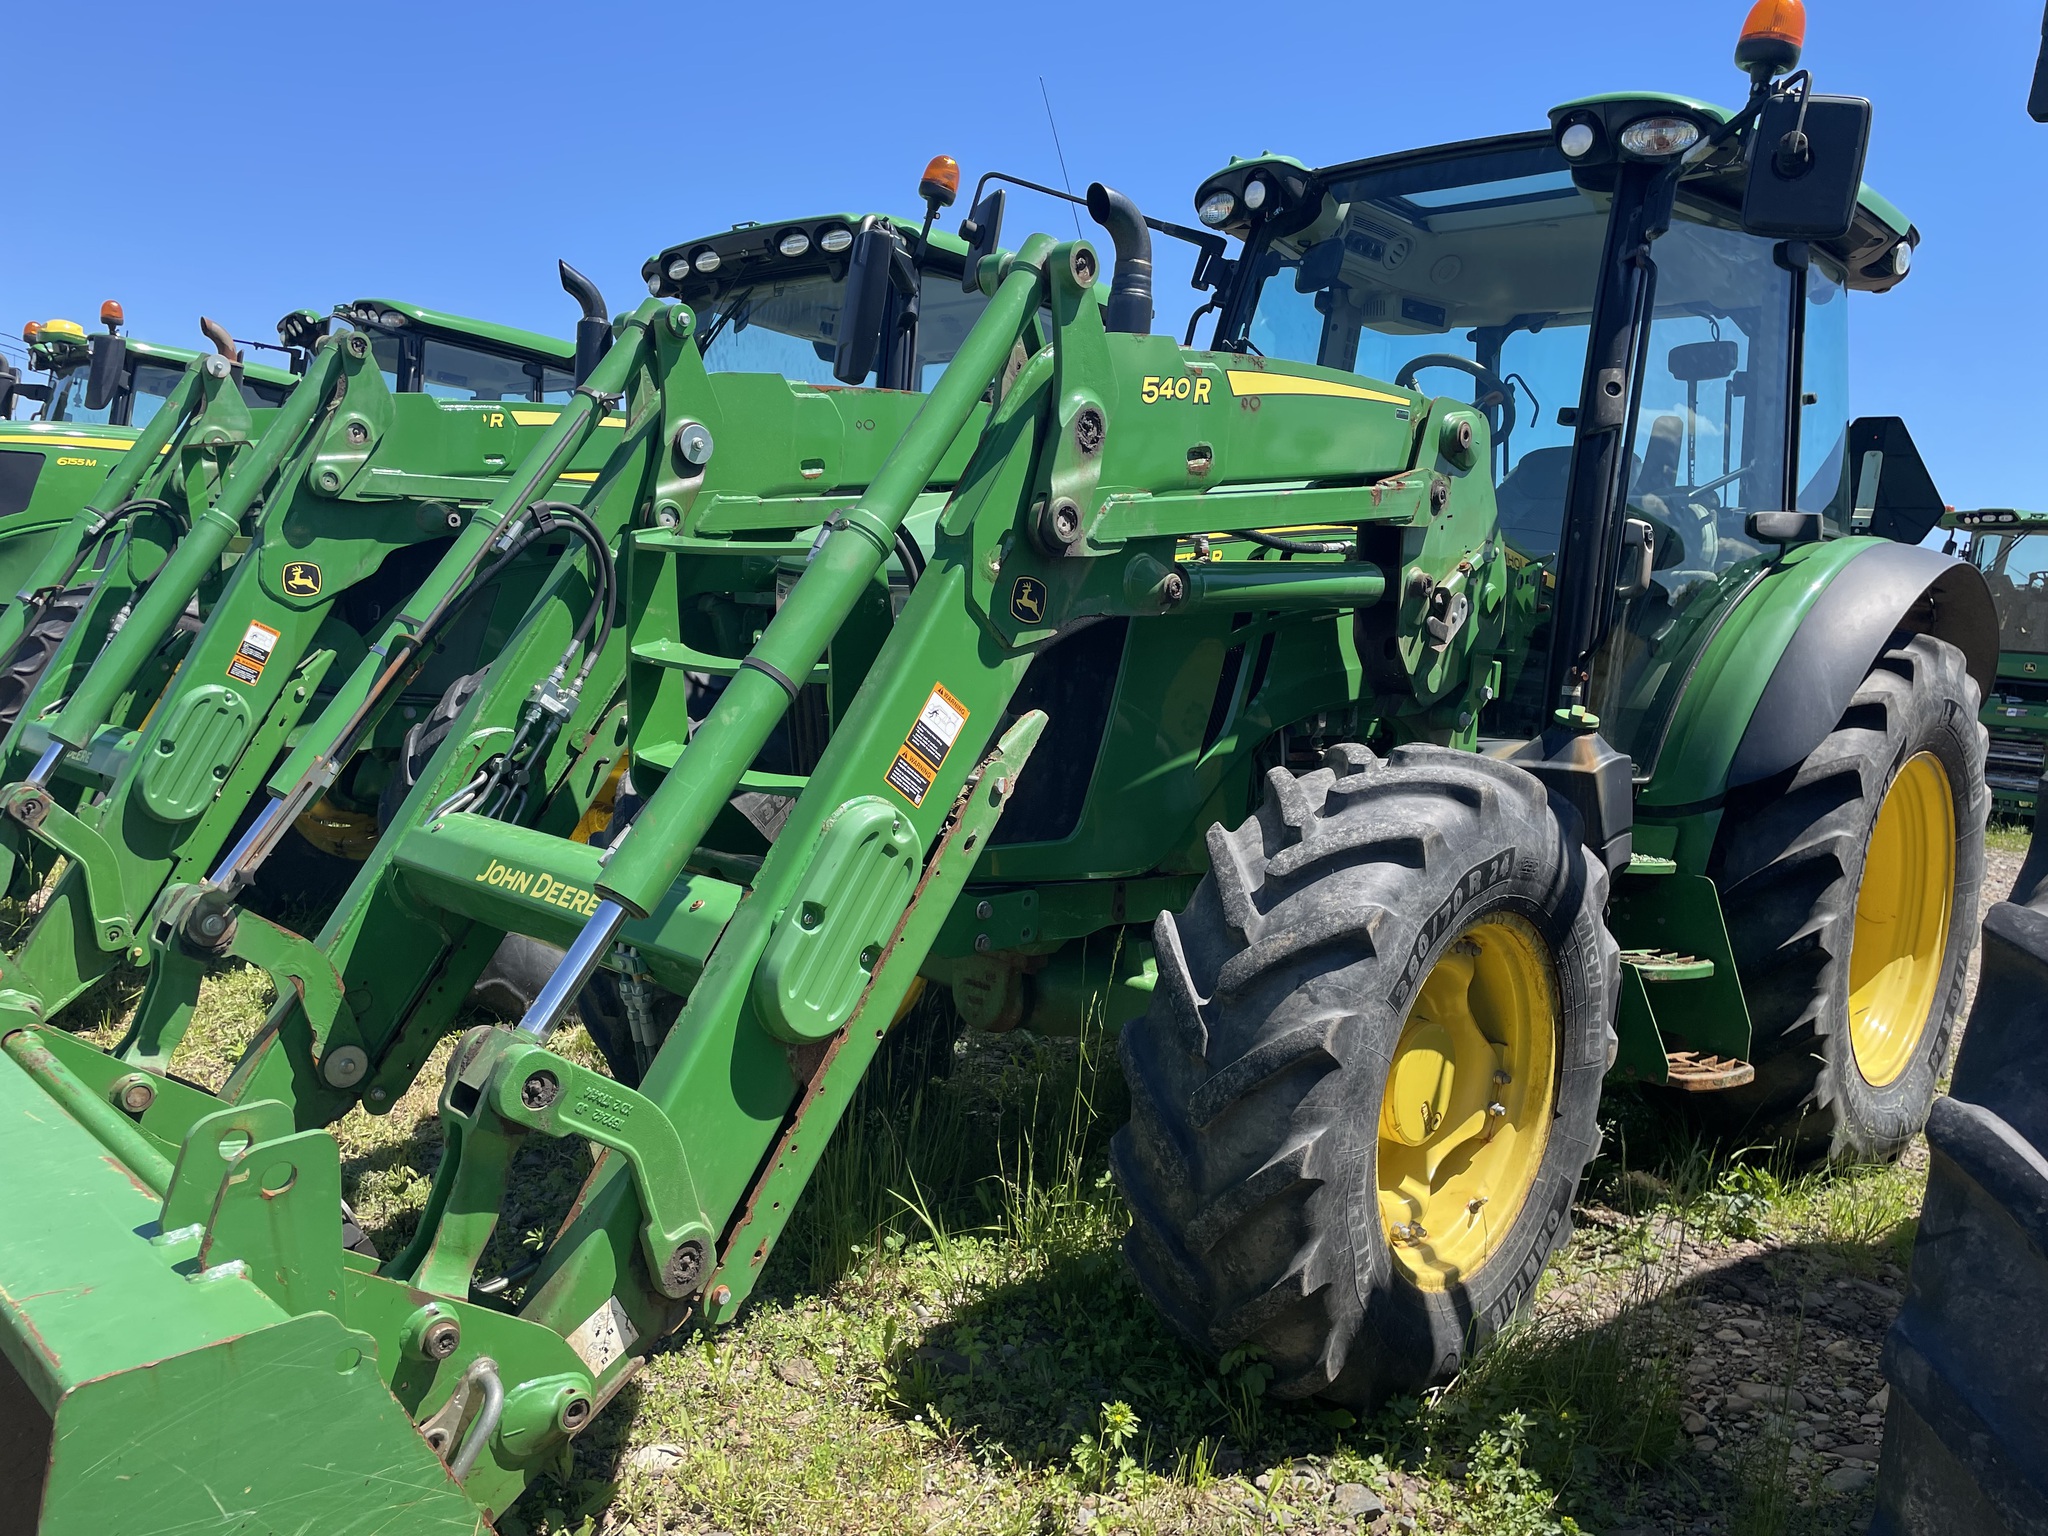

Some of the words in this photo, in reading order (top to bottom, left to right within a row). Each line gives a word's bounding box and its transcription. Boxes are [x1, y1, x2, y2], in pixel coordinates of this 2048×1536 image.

[943, 690, 966, 716] WARNING
[909, 756, 932, 779] WARNING
[475, 859, 535, 894] JOHN
[530, 873, 603, 917] DEERE
[1395, 886, 1464, 1004] 380/70
[1468, 869, 1483, 896] R
[1488, 852, 1511, 885] 24
[1575, 908, 1603, 1062] MICHELIN
[1491, 1208, 1561, 1333] OMNIBIB
